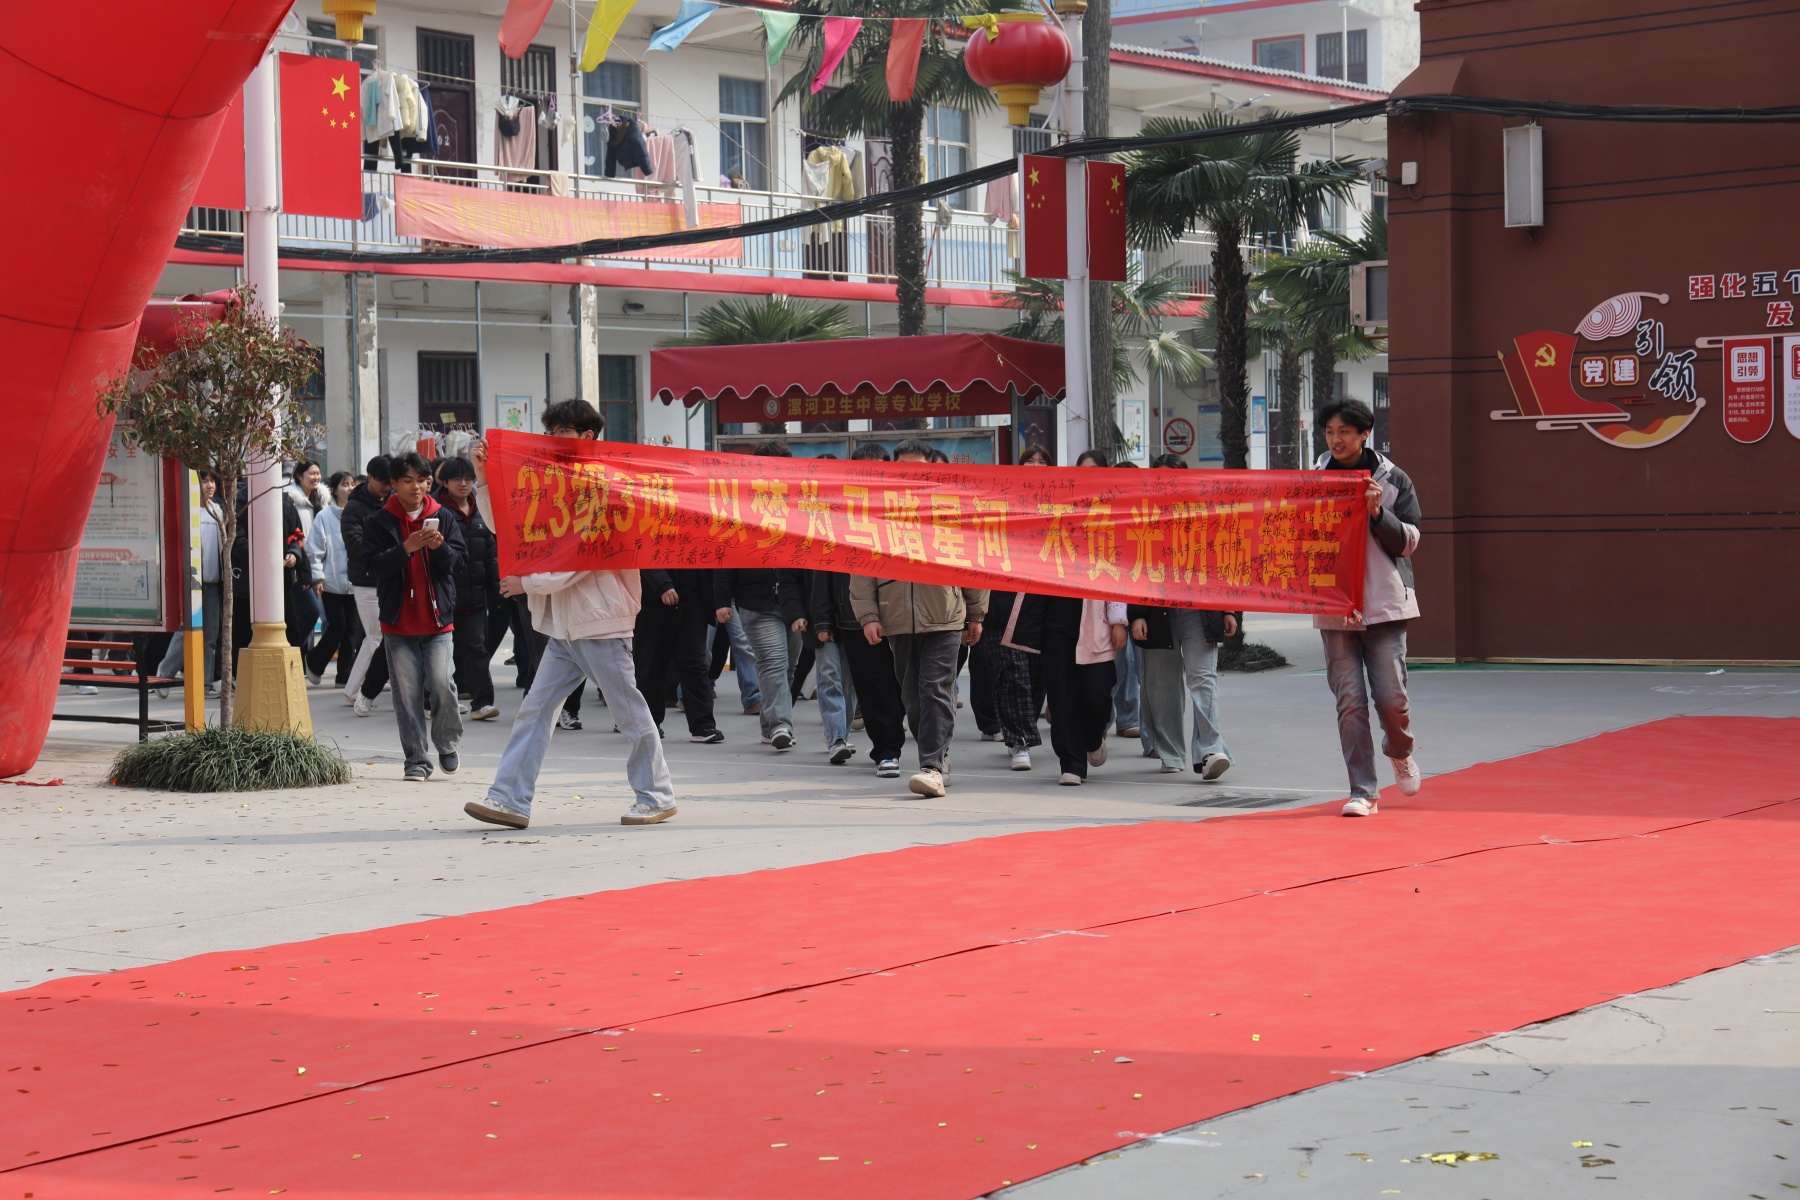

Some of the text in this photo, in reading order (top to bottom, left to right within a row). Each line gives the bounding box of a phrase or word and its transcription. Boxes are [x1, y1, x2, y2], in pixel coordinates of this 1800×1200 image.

[1635, 318, 1698, 402] 引领
[1737, 352, 1758, 363] 思想
[1583, 358, 1637, 385] 党建
[1737, 366, 1758, 377] 引领
[787, 392, 961, 416] 漯河卫生中等专业学校
[517, 462, 680, 543] 23级3班
[708, 478, 1012, 573] 以梦为马踏星河
[1037, 496, 1342, 590] 不负光阴砺锋芒
